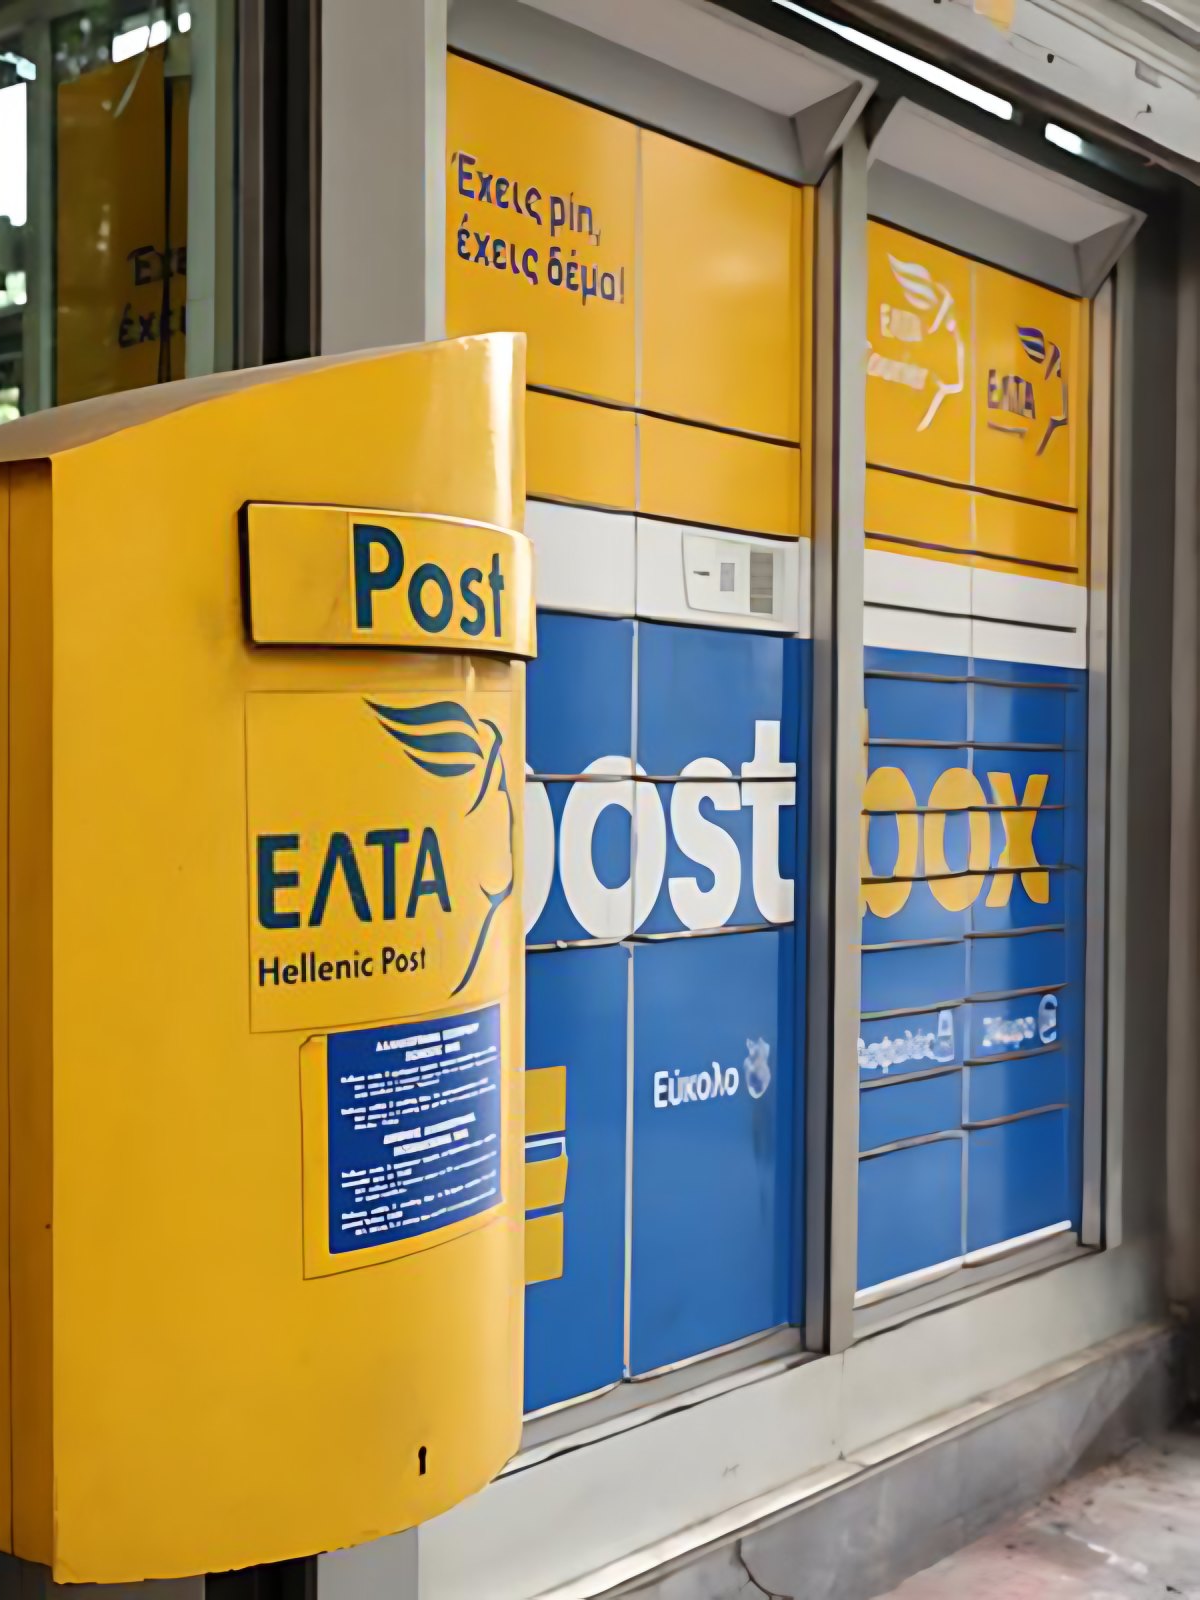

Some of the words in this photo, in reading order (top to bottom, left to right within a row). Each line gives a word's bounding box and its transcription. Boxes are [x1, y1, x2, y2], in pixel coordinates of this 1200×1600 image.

[451, 152, 542, 225] Έχεις
[457, 213, 539, 286] έχεις
[353, 522, 505, 638] Post
[525, 719, 797, 942] ost
[257, 826, 452, 930] ΕΛΤΑ
[258, 950, 374, 987] Hellenic
[382, 946, 426, 975] Post
[653, 1061, 740, 1109] Εύκολο
